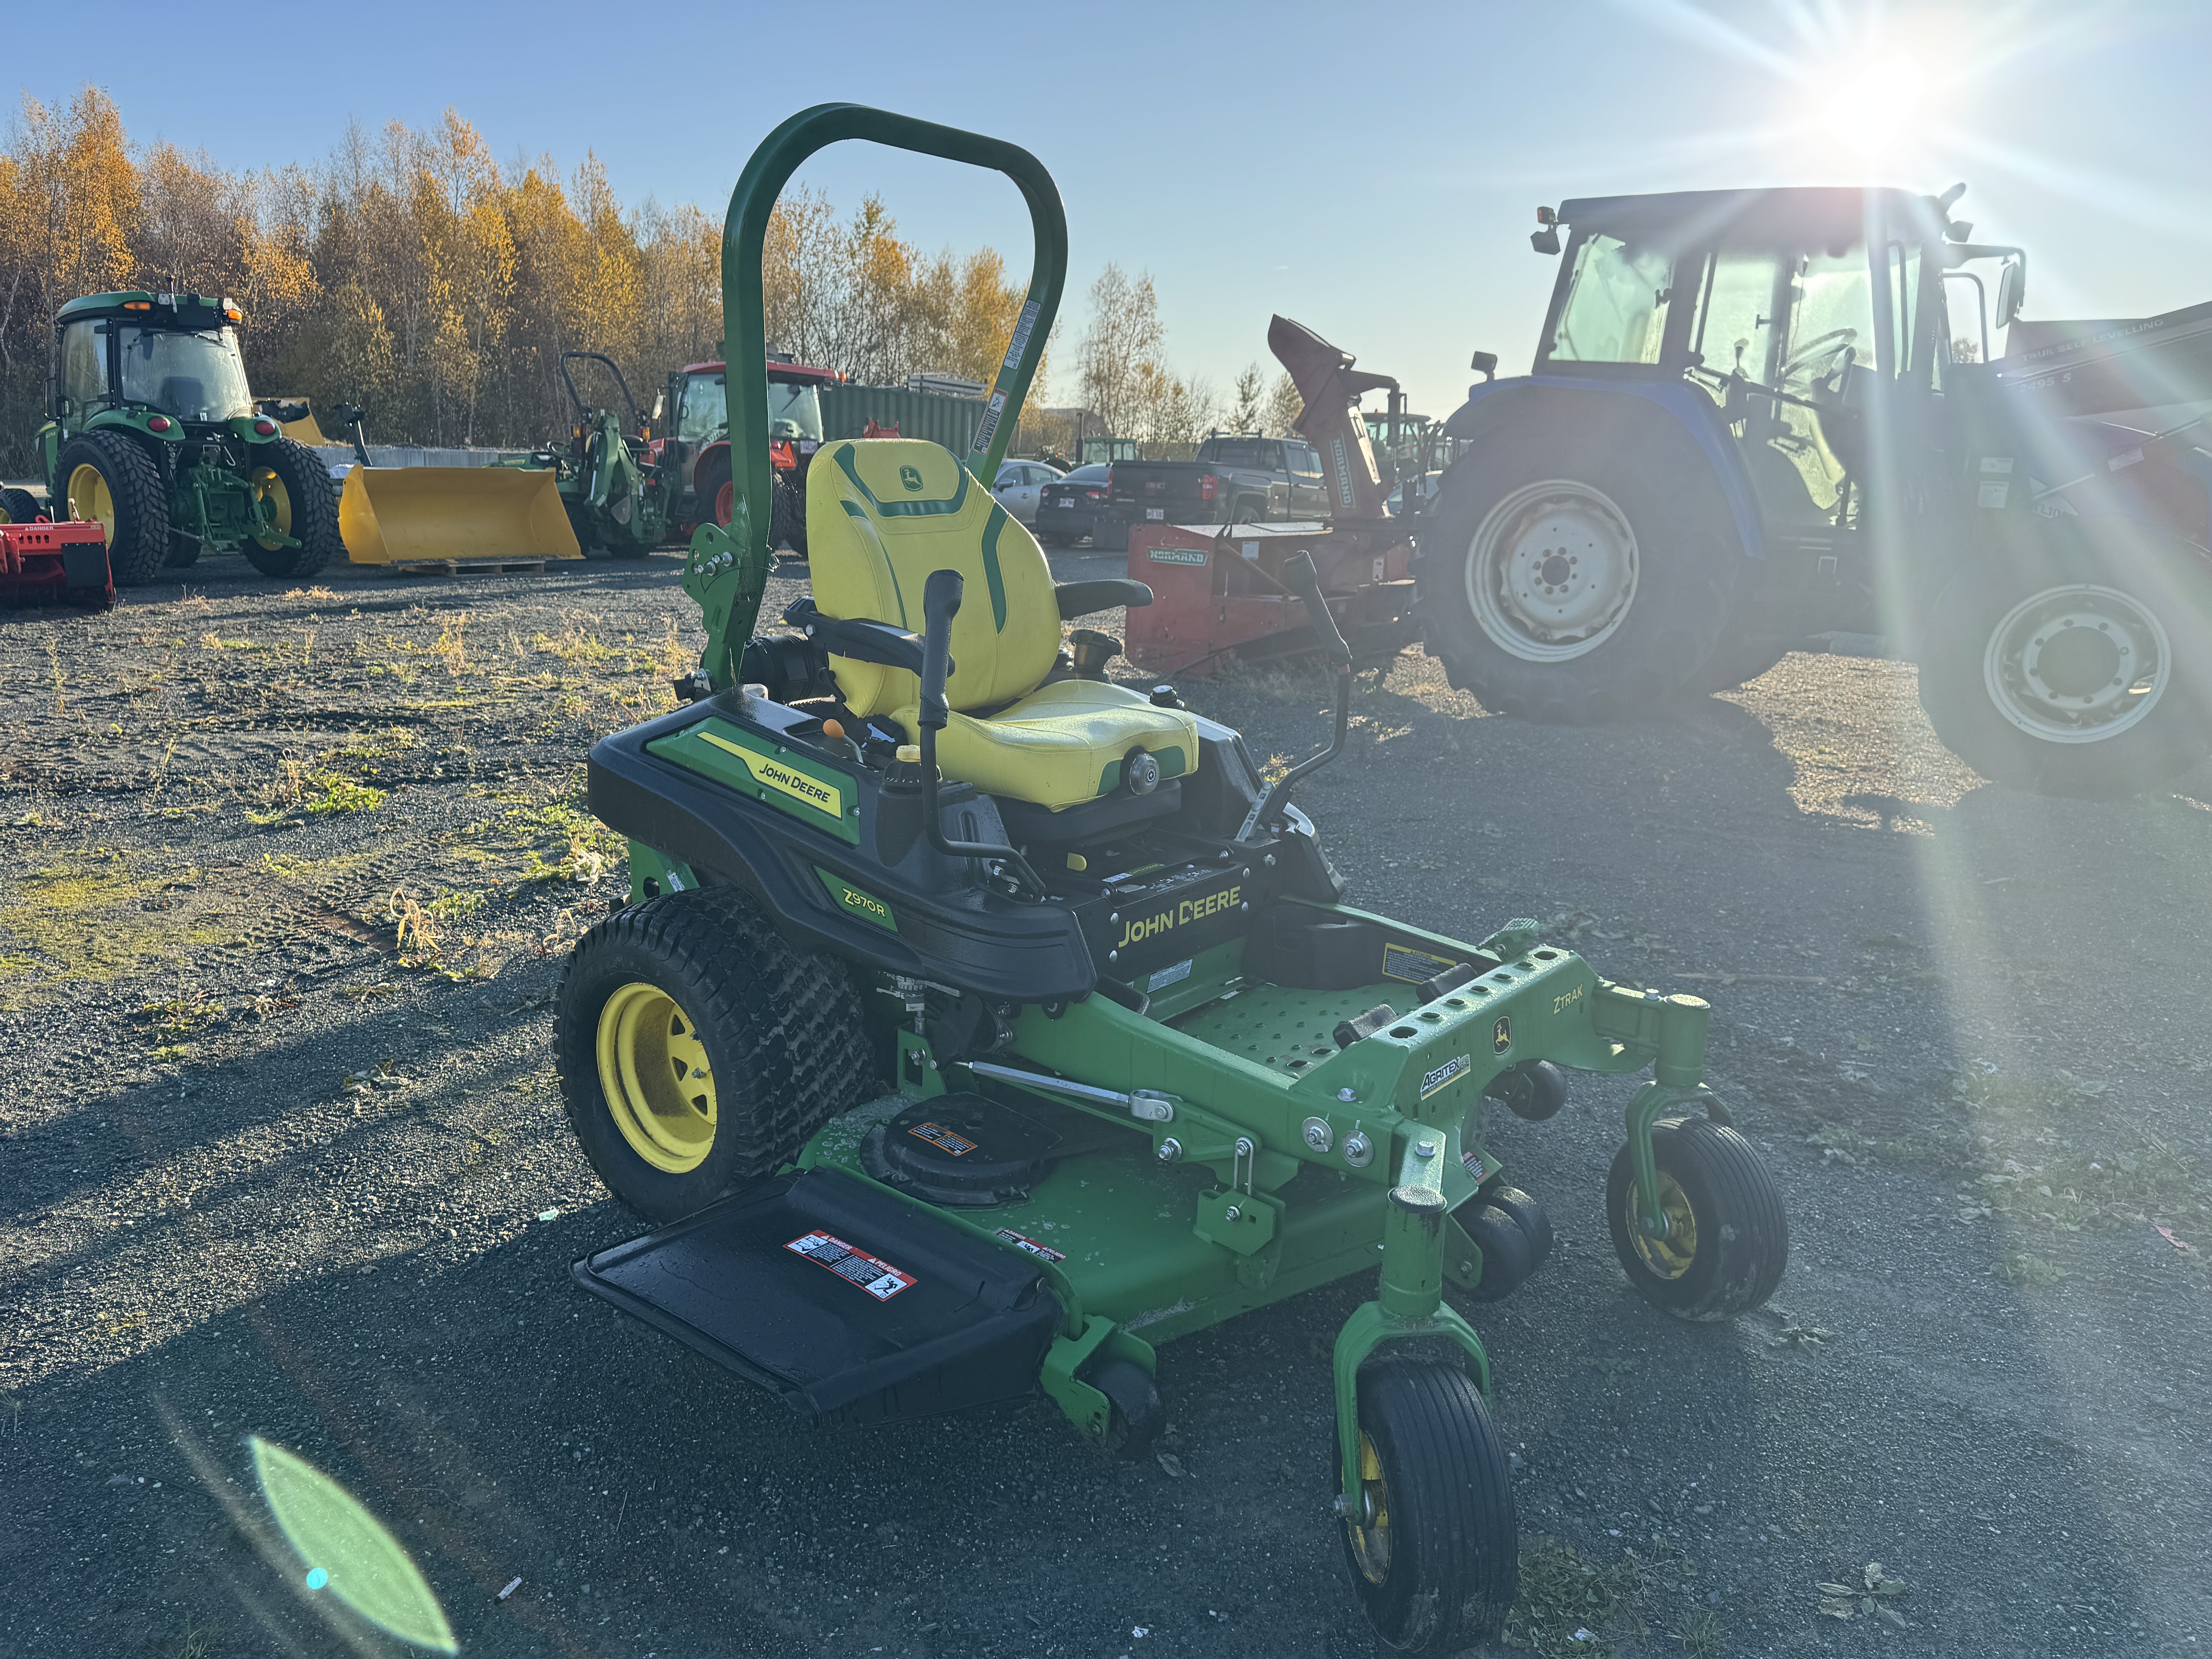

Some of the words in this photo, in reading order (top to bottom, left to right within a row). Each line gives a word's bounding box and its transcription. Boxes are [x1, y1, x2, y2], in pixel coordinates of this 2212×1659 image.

[2021, 350, 2054, 362] TRUE
[2093, 319, 2164, 343] LEVELLING
[2062, 373, 2072, 383] S
[1333, 438, 1352, 504] NORMAND
[1150, 550, 1203, 562] NORMAND
[759, 764, 790, 785] JOHN
[790, 776, 831, 803] DEERE
[842, 887, 886, 917] Z970R
[1118, 910, 1173, 948] JOHN
[1179, 886, 1240, 925] DEERE
[1554, 984, 1583, 1015] ZTRAK
[1422, 1056, 1460, 1090] AGRITEX
[828, 1237, 852, 1250] DANGER
[875, 1261, 902, 1276] PELIGRO
